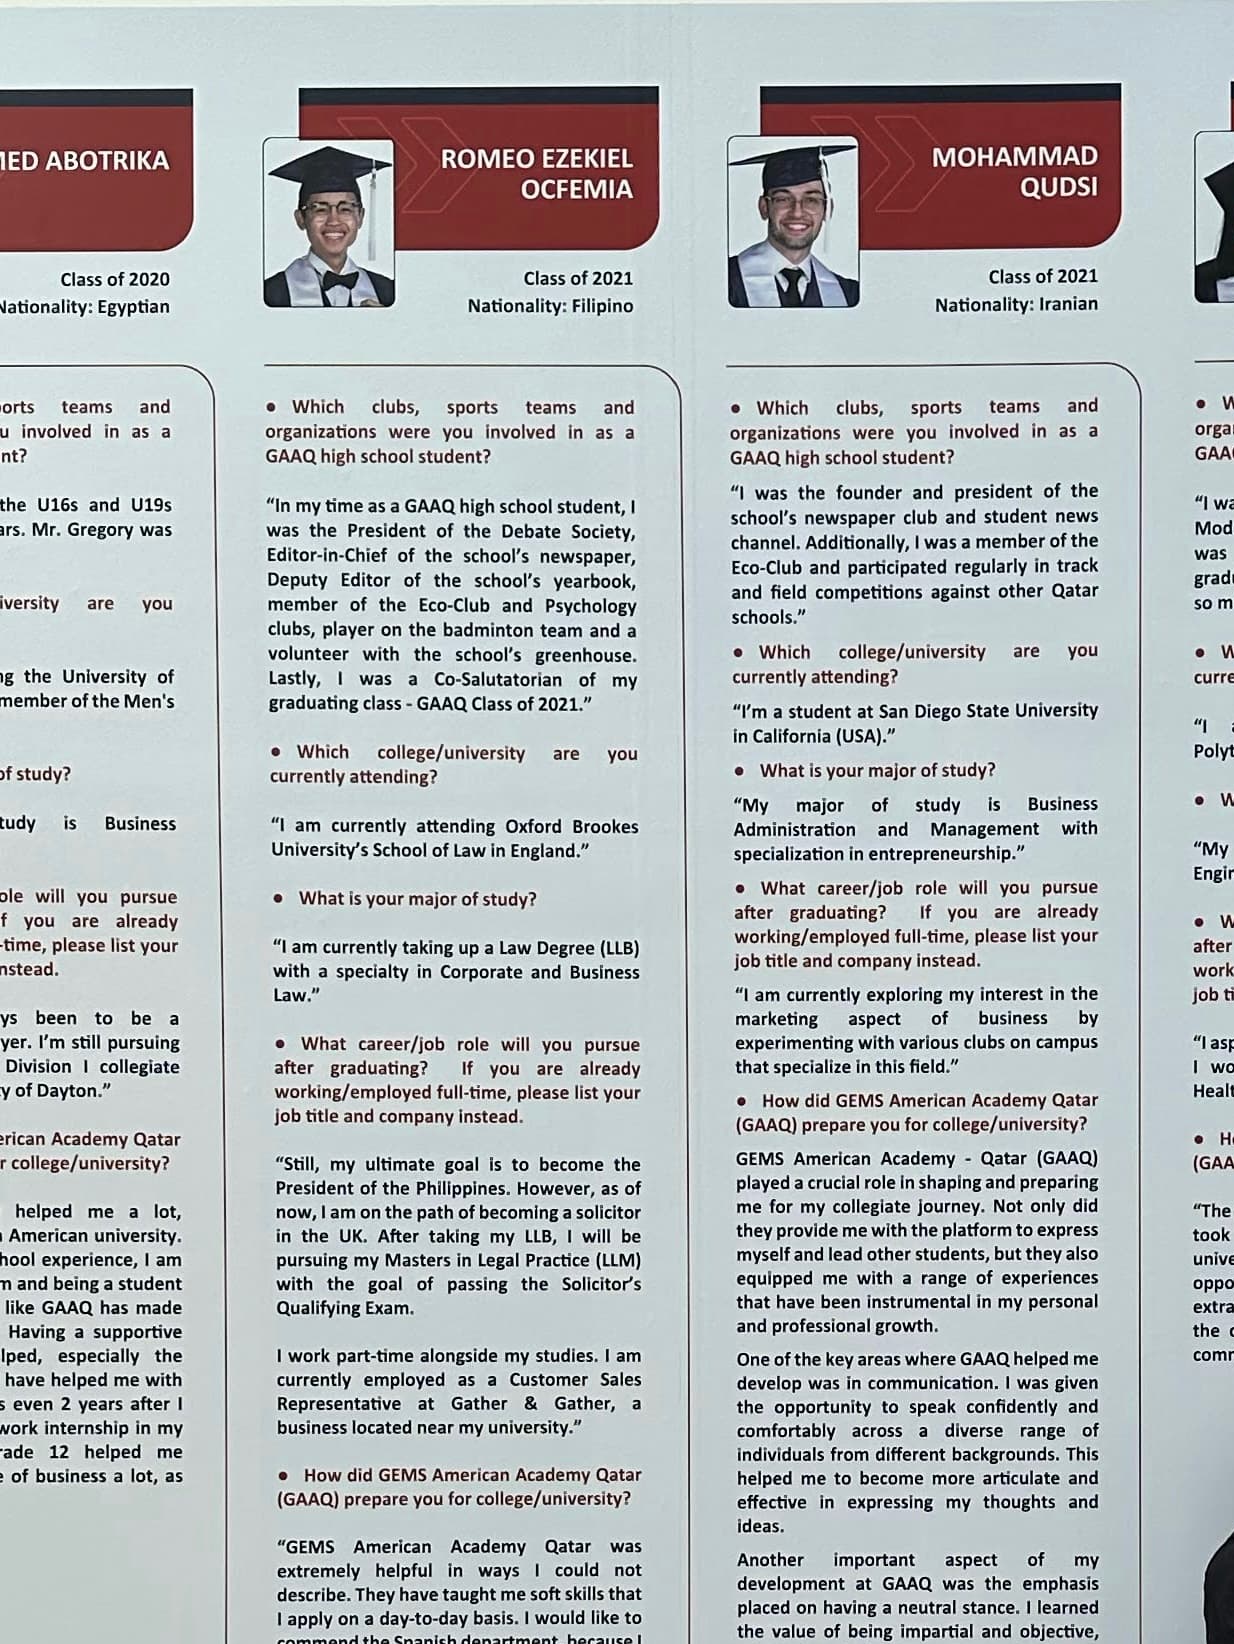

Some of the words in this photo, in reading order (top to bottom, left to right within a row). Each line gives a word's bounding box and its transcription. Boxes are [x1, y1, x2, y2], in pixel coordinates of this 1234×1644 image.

[0, 151, 38, 170] ED
[46, 151, 169, 170] ABOTRIKA
[442, 149, 534, 168] ROMEO
[543, 149, 633, 168] EZEKIEL
[933, 146, 1098, 167] MOHAMMAD
[522, 179, 633, 199] OCFEMIA
[1021, 177, 1097, 199] QUDSI
[61, 272, 102, 286] Class
[107, 272, 125, 286] of
[129, 272, 170, 286] 2020
[524, 271, 566, 285] Class
[571, 270, 588, 285] of
[592, 271, 633, 285] 2021
[989, 269, 1031, 284] Class
[1036, 268, 1053, 283] of
[1058, 269, 1098, 283] 2021
[98, 299, 169, 317] Egyptian
[469, 298, 567, 316] Nationality:
[573, 298, 633, 316] Filipino
[936, 296, 1034, 315] Nationality:
[1040, 296, 1098, 311] Iranian
[292, 399, 344, 414] Which
[372, 399, 419, 416] clubs,
[448, 401, 498, 417] sports
[526, 401, 576, 414] teams
[604, 400, 634, 414] and
[730, 451, 781, 467] GAAQ
[786, 450, 819, 468] high
[825, 449, 877, 465] school
[883, 449, 954, 464] student?
[38, 498, 78, 512] U16s
[89, 497, 119, 512] and
[132, 498, 172, 512] U19s
[732, 560, 802, 575] Eco-Club
[810, 560, 840, 574] and
[848, 559, 946, 578] participated
[955, 558, 1027, 577] regularly
[1035, 558, 1049, 573] in
[1057, 557, 1098, 572] track
[734, 822, 855, 836] Administration
[878, 822, 908, 836] and
[931, 822, 1039, 839] Management
[1062, 820, 1097, 835] with
[273, 963, 310, 978] with
[319, 967, 328, 978] a
[336, 964, 409, 982] specialty
[417, 964, 431, 978] in
[441, 965, 522, 982] Corporate
[531, 964, 561, 979] and
[571, 965, 640, 979] Business
[6, 1059, 71, 1073] Division
[84, 1059, 88, 1073] I
[100, 1059, 180, 1077] collegiate
[278, 1396, 401, 1414] Representative
[418, 1398, 434, 1410] at
[452, 1396, 508, 1410] Gather
[525, 1396, 537, 1410] &
[555, 1396, 615, 1413] Gather,
[632, 1400, 641, 1410] a
[45, 1420, 128, 1438] internship
[136, 1420, 150, 1435] in
[158, 1424, 183, 1438] my
[737, 1552, 804, 1566] Another
[834, 1552, 915, 1570] important
[946, 1554, 998, 1570] aspect
[1028, 1552, 1045, 1566] of
[1075, 1556, 1099, 1570] my
